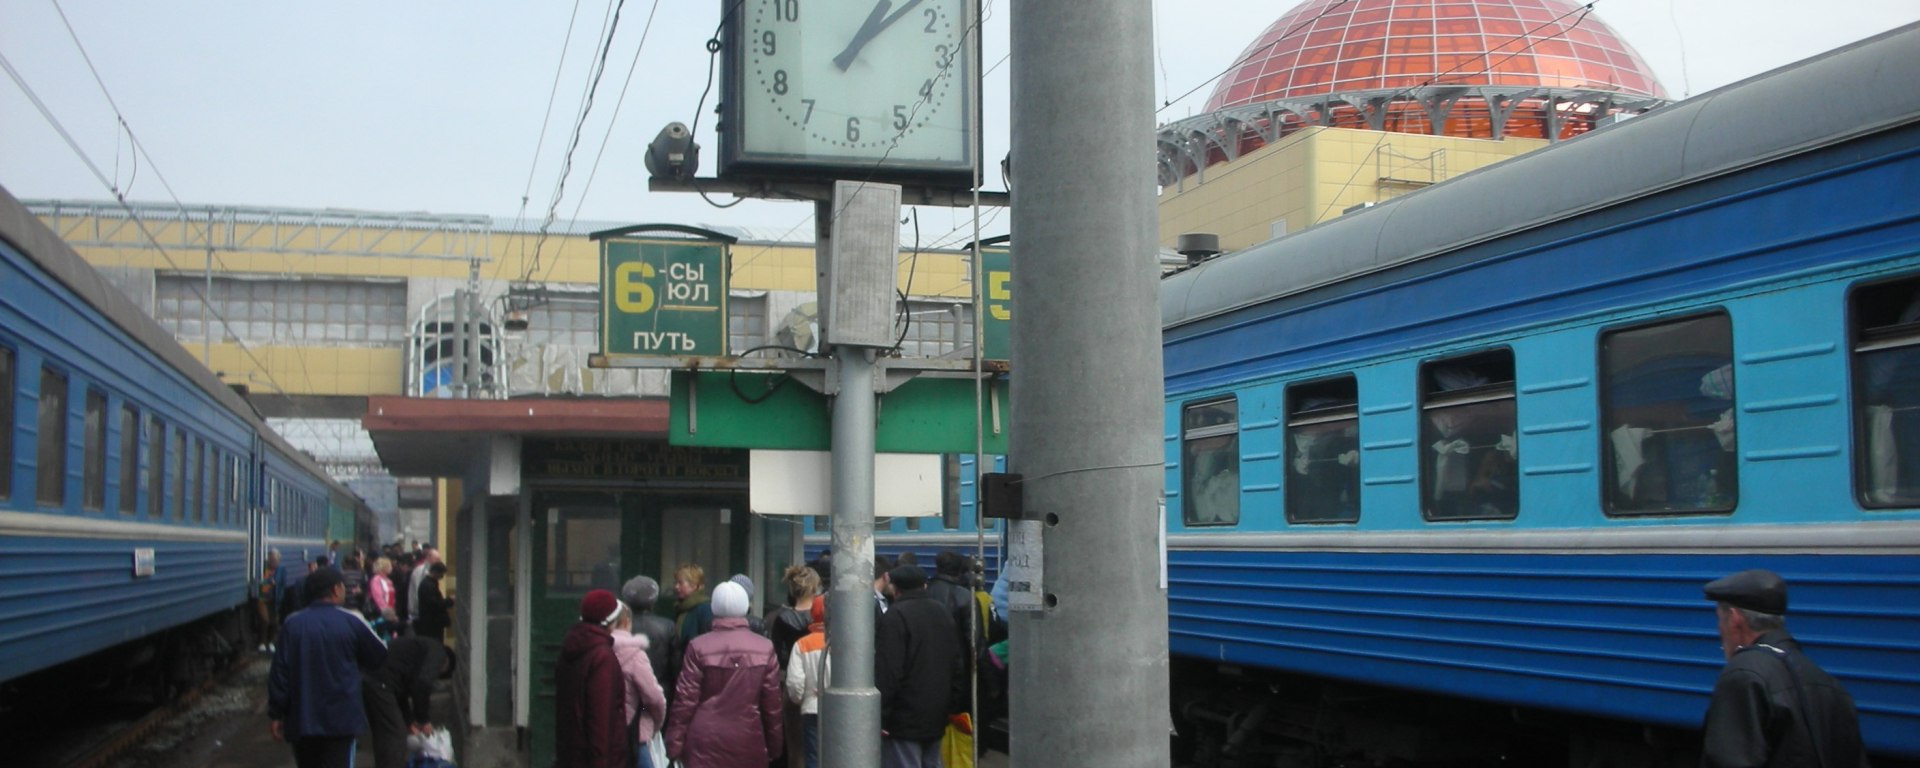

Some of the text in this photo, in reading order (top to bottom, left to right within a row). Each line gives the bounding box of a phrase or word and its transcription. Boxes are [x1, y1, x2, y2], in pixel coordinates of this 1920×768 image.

[773, 0, 798, 22] 10
[923, 8, 937, 33] 2
[762, 31, 776, 56] 9
[935, 44, 949, 70] 3
[773, 70, 788, 96] 8
[919, 79, 933, 104] 4
[801, 99, 816, 124] 7
[893, 105, 907, 130] 5
[846, 117, 860, 142] 6
[615, 261, 655, 314] 6
[668, 282, 709, 302] ЮЛ
[633, 331, 696, 351] ПУТЬ
